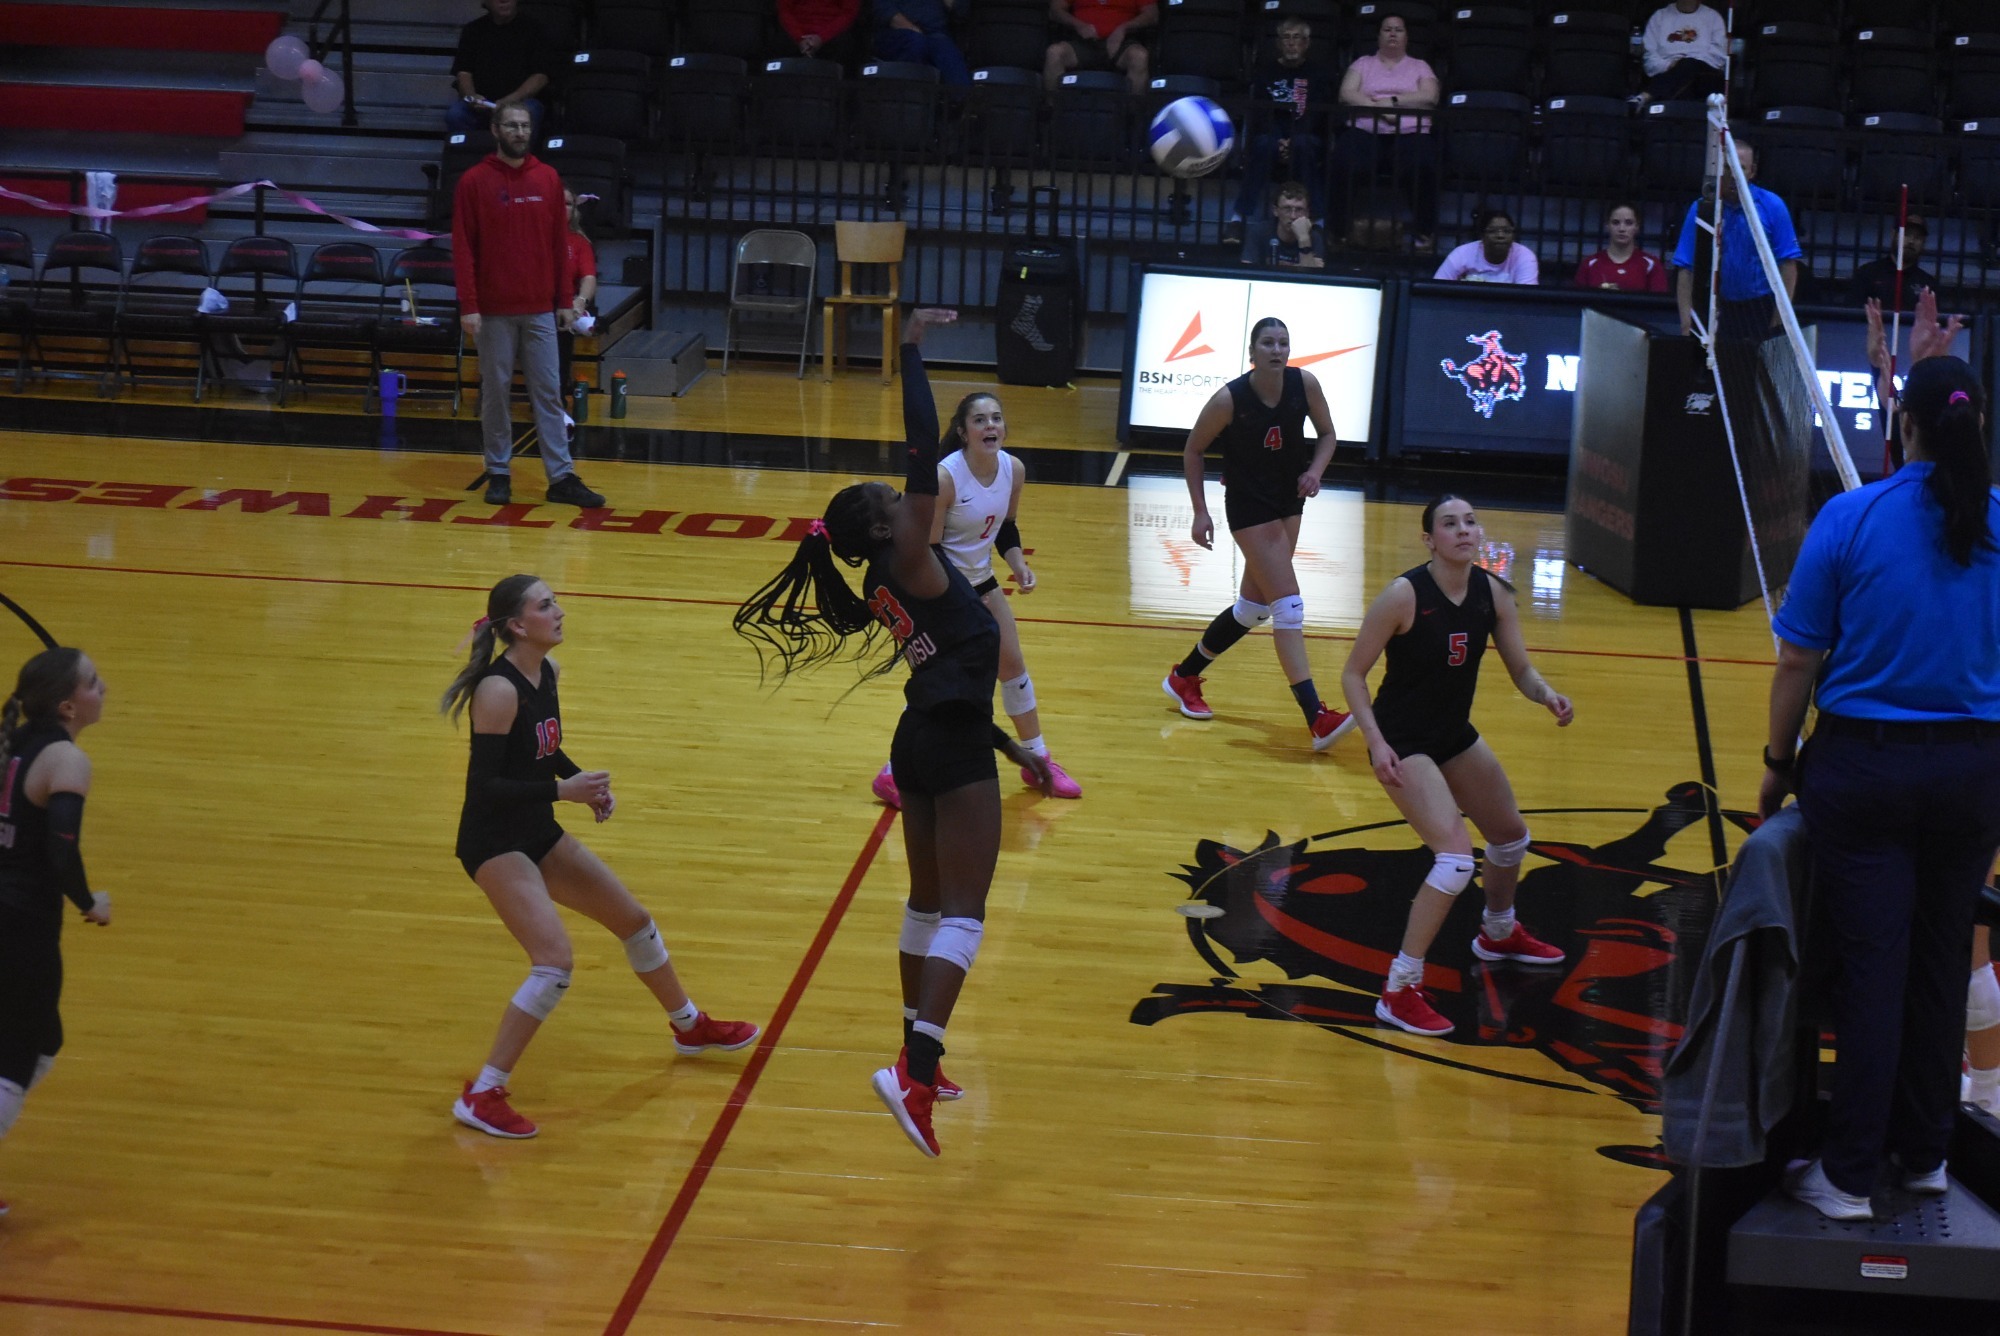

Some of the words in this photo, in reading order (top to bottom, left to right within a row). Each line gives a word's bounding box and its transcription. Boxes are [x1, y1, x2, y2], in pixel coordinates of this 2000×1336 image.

[1138, 386, 1152, 394] THE
[1140, 371, 1173, 384] BSN
[1176, 374, 1228, 387] SPORTS
[1264, 426, 1282, 451] 4
[980, 515, 995, 539] 2
[1447, 632, 1468, 667] 5
[536, 717, 560, 760] 18
